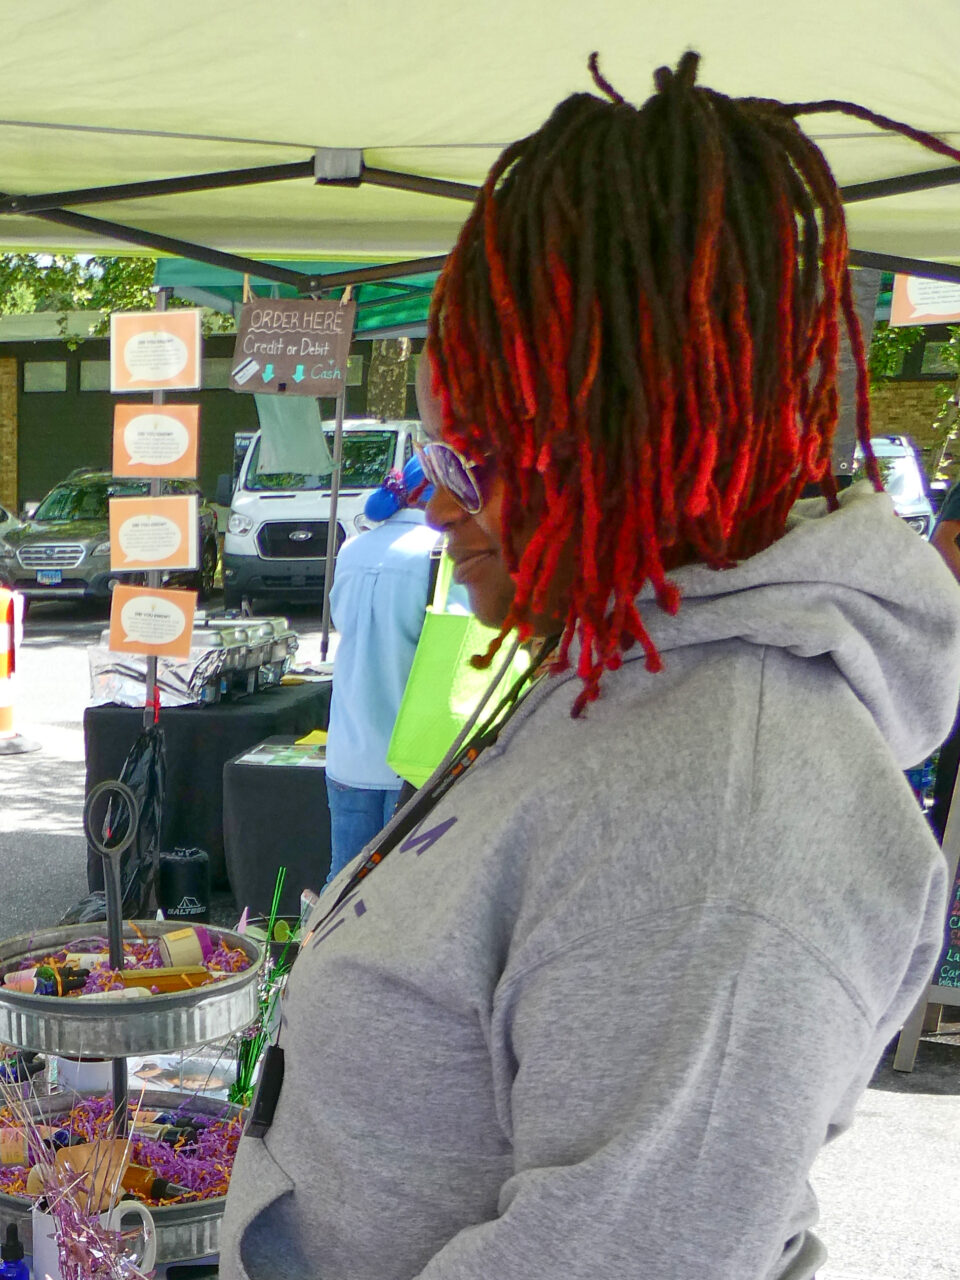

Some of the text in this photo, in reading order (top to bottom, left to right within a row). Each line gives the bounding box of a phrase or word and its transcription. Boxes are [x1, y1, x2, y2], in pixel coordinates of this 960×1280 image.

[250, 309, 345, 331] ORDER HERE
[243, 334, 330, 356] Credit or Debit
[310, 363, 342, 379] Cash
